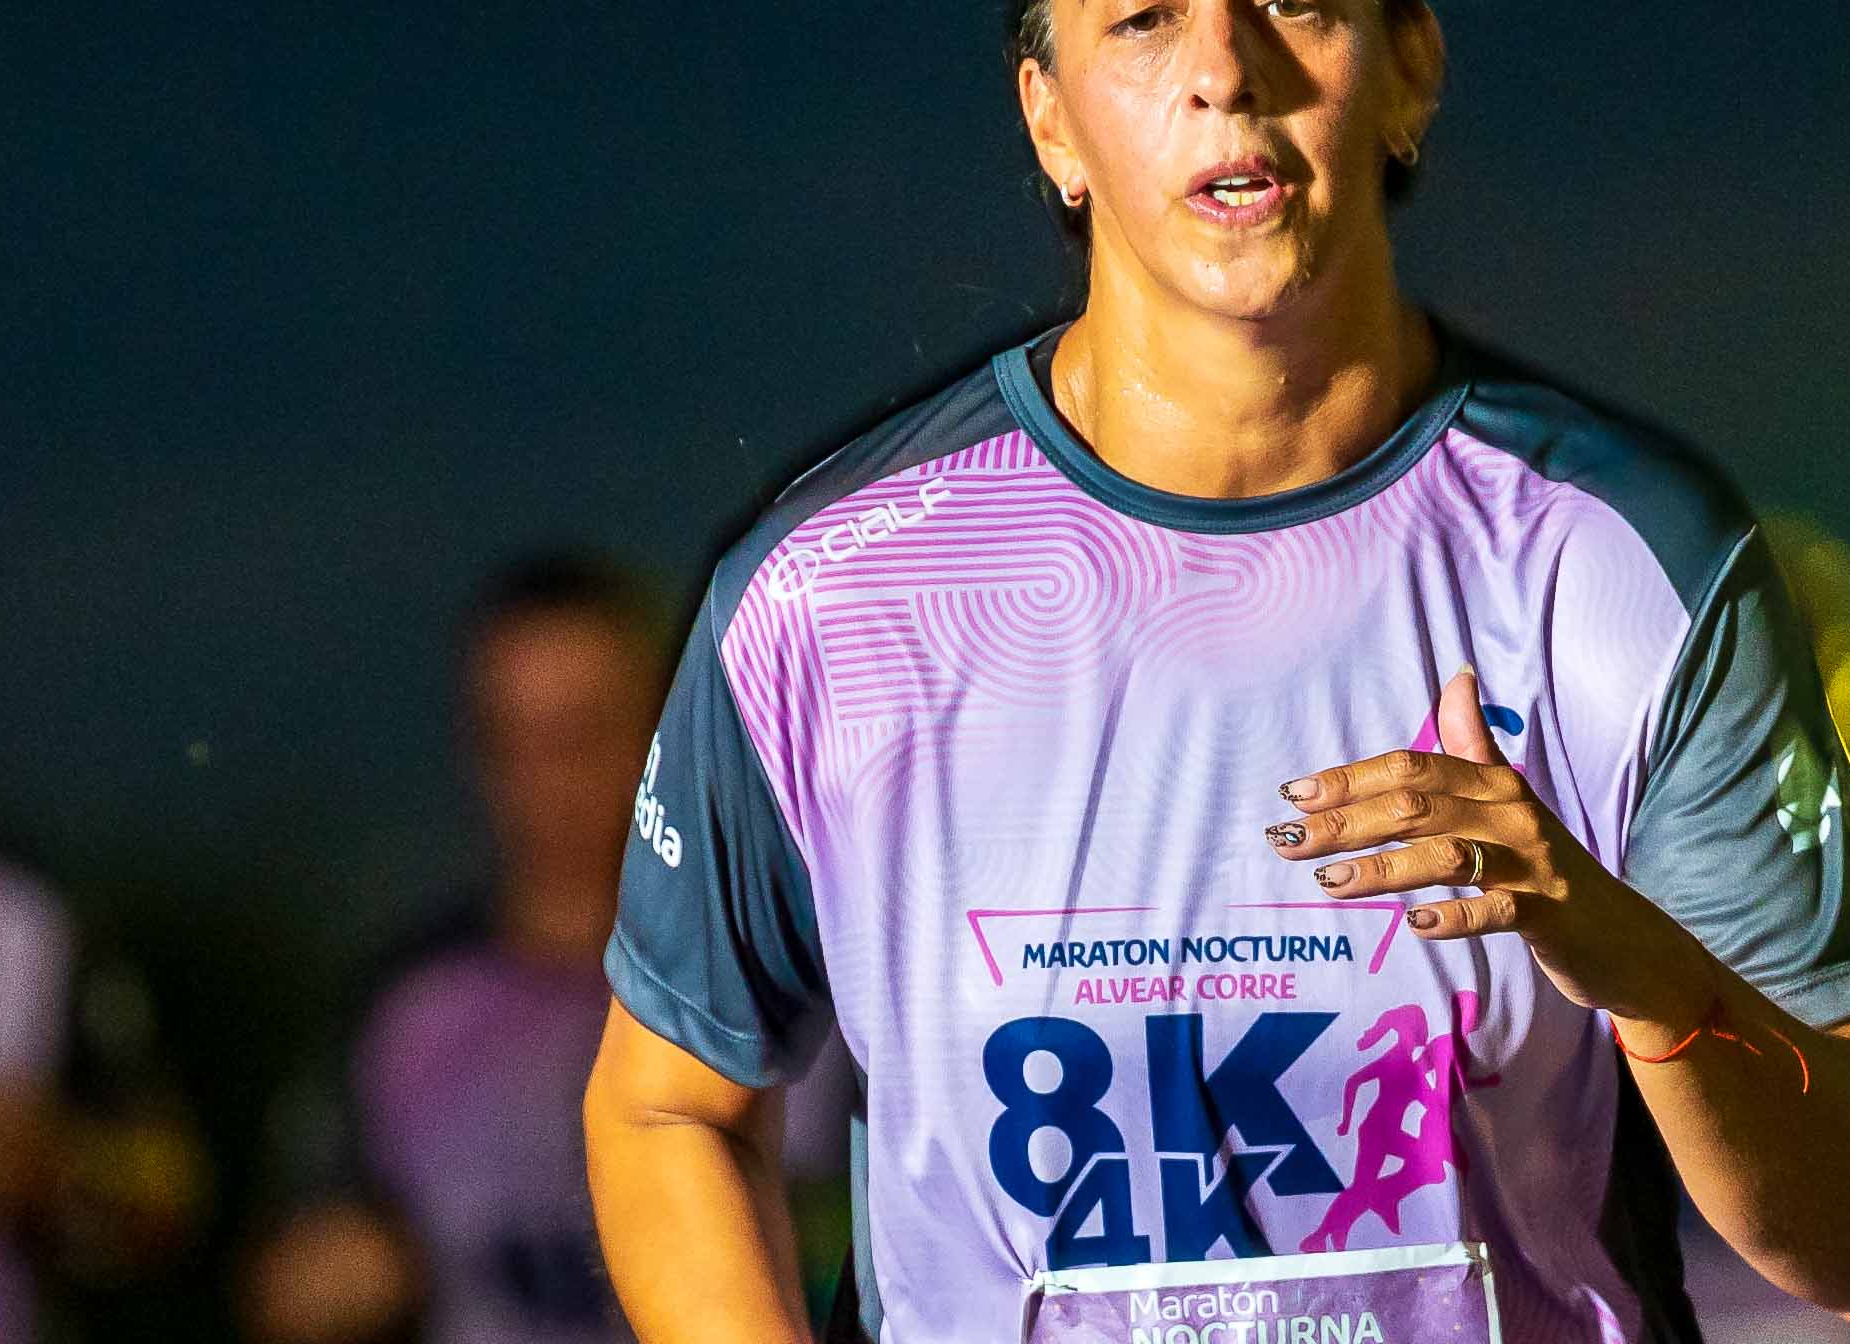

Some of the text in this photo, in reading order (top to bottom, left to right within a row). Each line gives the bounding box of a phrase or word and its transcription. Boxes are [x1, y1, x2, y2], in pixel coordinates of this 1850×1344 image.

[1022, 934, 1354, 969] MARATON NOCTURNA
[1073, 973, 1297, 1006] ALVEAR CORRE
[981, 1011, 1347, 1219] 8K
[1045, 1157, 1276, 1272] 4K
[1129, 1282, 1278, 1323] Maratón
